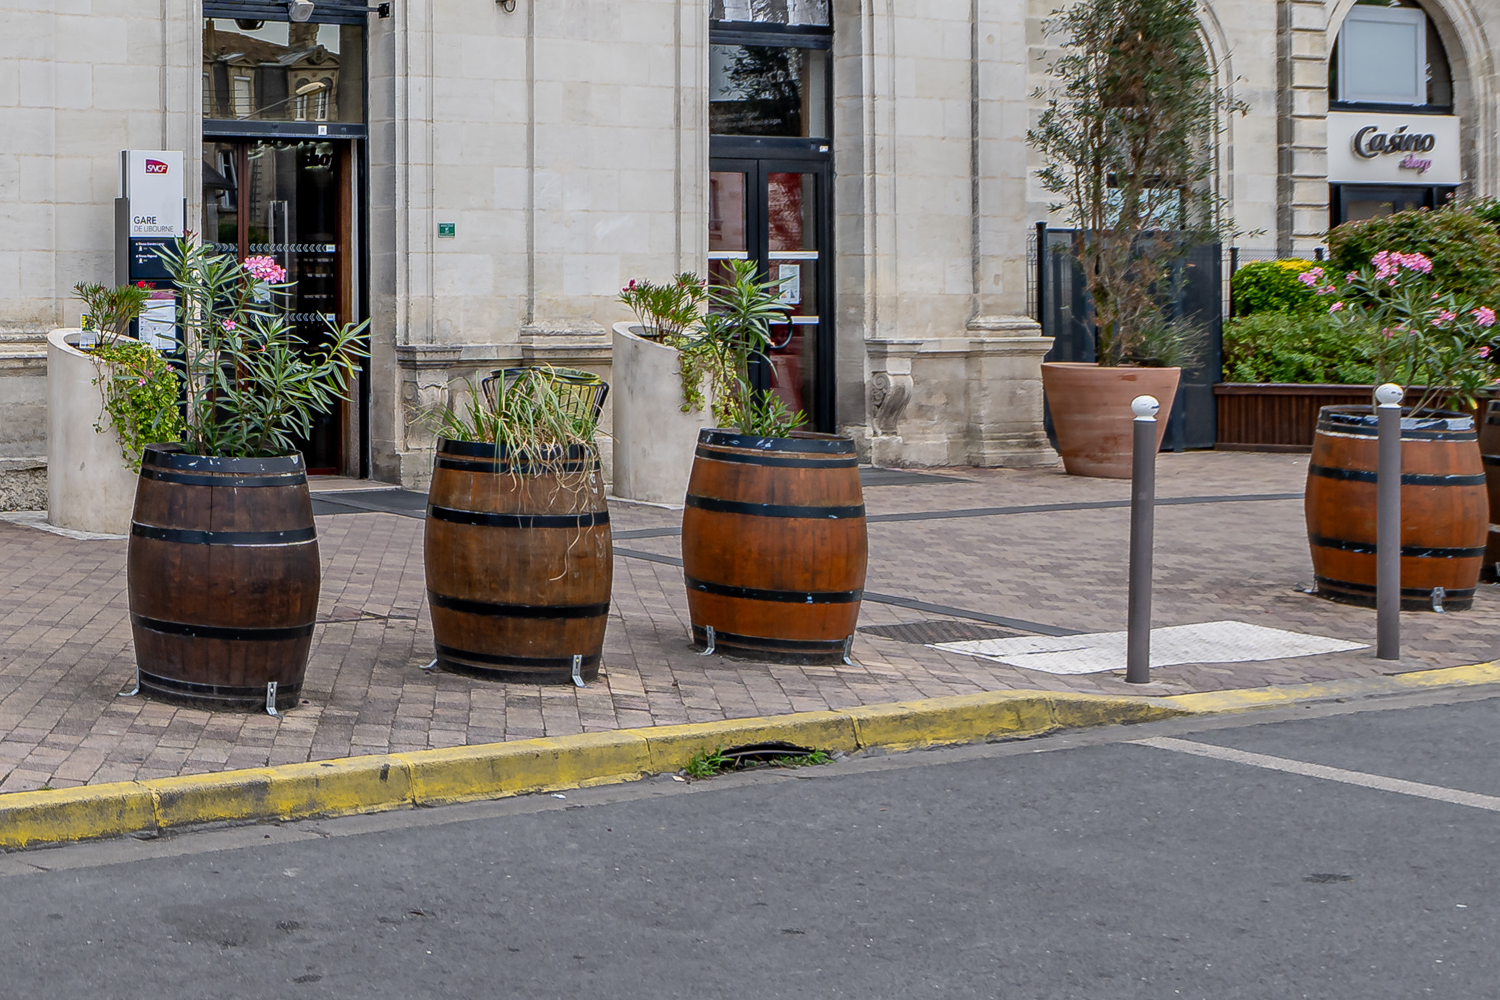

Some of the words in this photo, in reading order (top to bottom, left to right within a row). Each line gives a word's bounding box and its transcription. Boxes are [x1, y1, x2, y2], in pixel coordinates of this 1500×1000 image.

[1352, 124, 1436, 159] Casino
[146, 163, 168, 174] SNCF
[133, 215, 158, 225] GARE
[133, 225, 143, 233] DE
[143, 225, 174, 233] LIBOURNE
